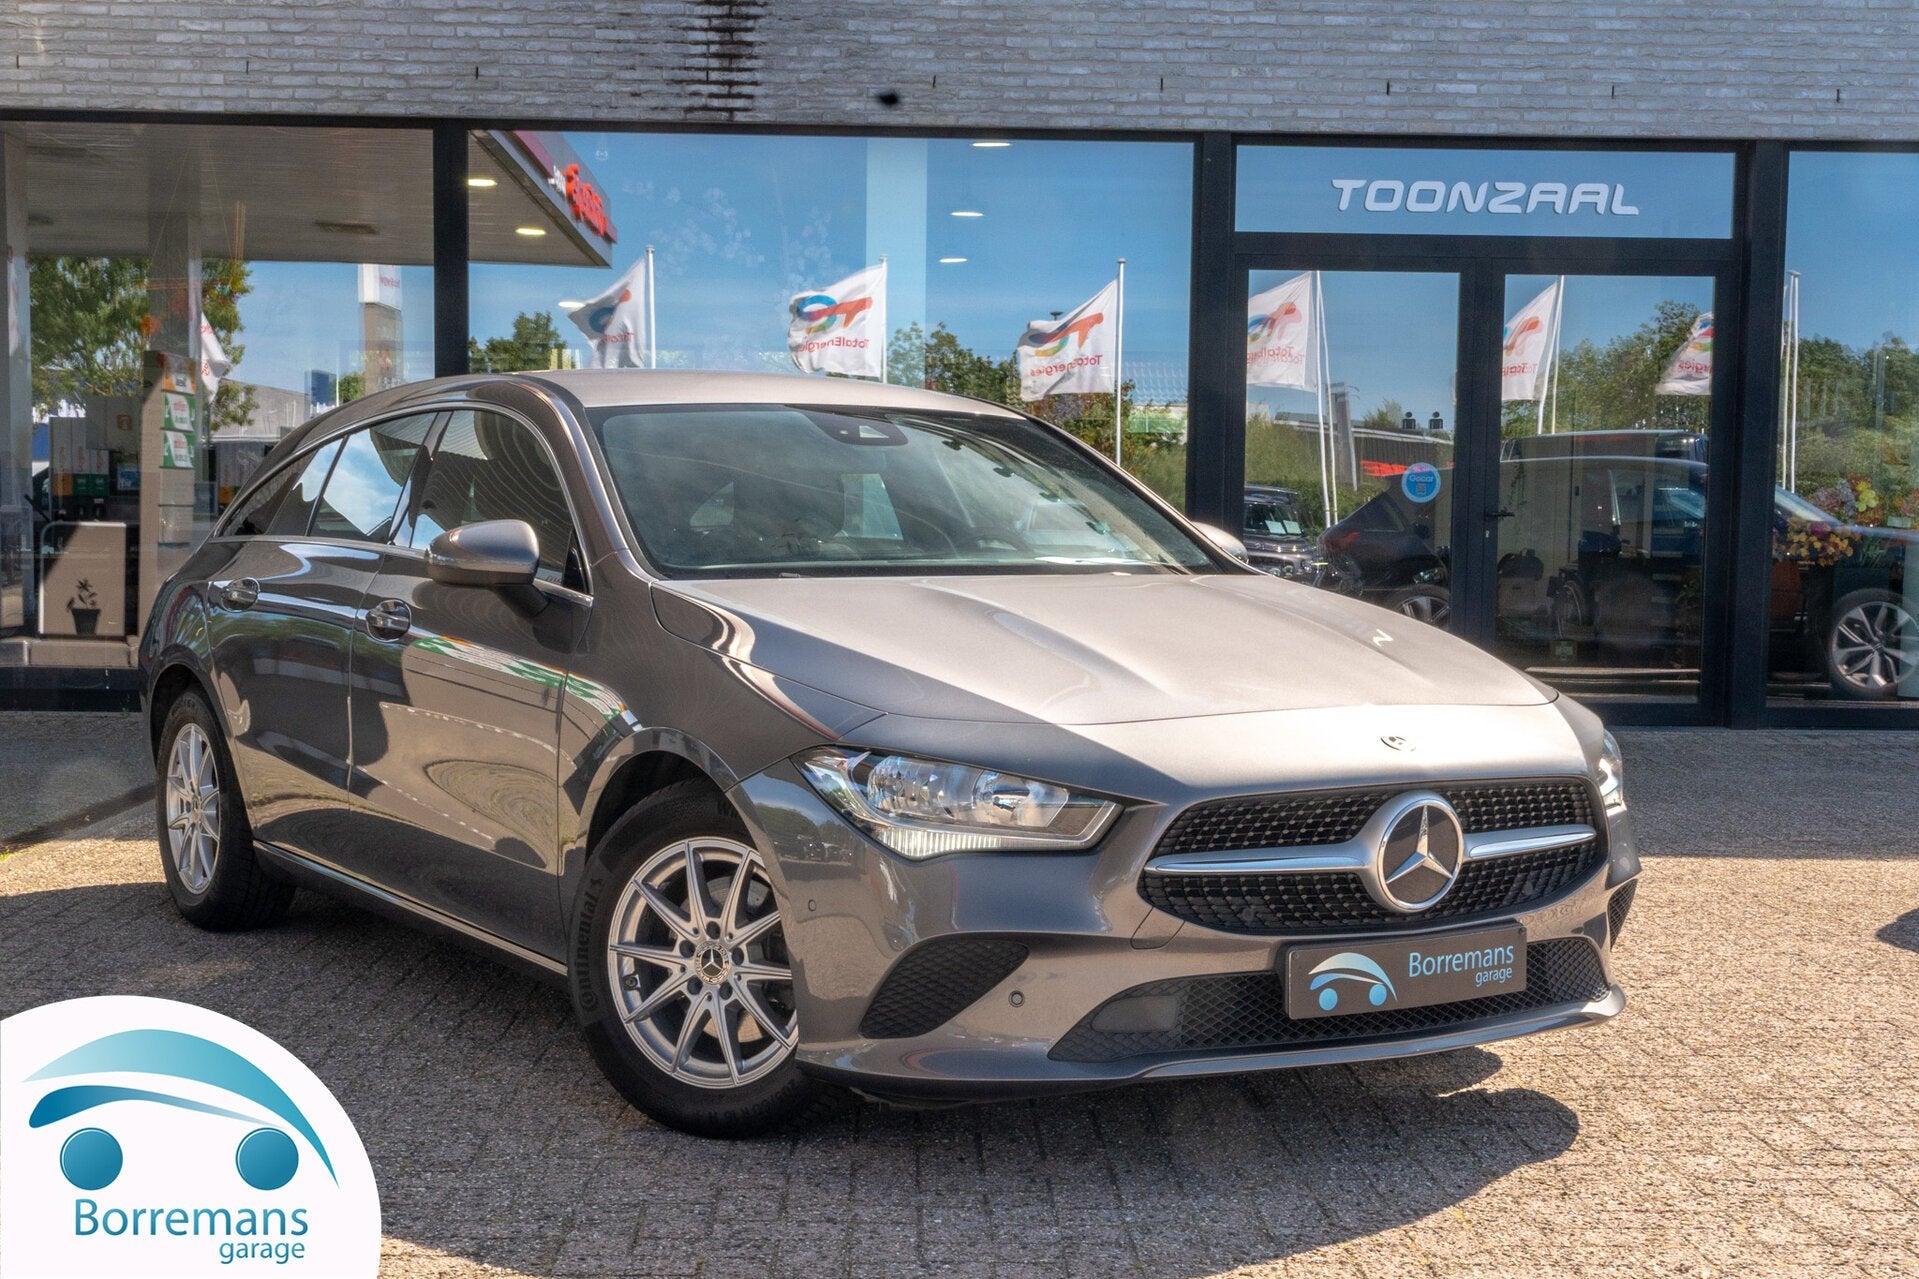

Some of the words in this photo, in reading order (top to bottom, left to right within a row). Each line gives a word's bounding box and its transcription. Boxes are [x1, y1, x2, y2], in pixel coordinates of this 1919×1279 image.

[1332, 179, 1639, 216] TOONZAAL
[1409, 945, 1514, 977] Borremans
[1475, 966, 1512, 988] garage
